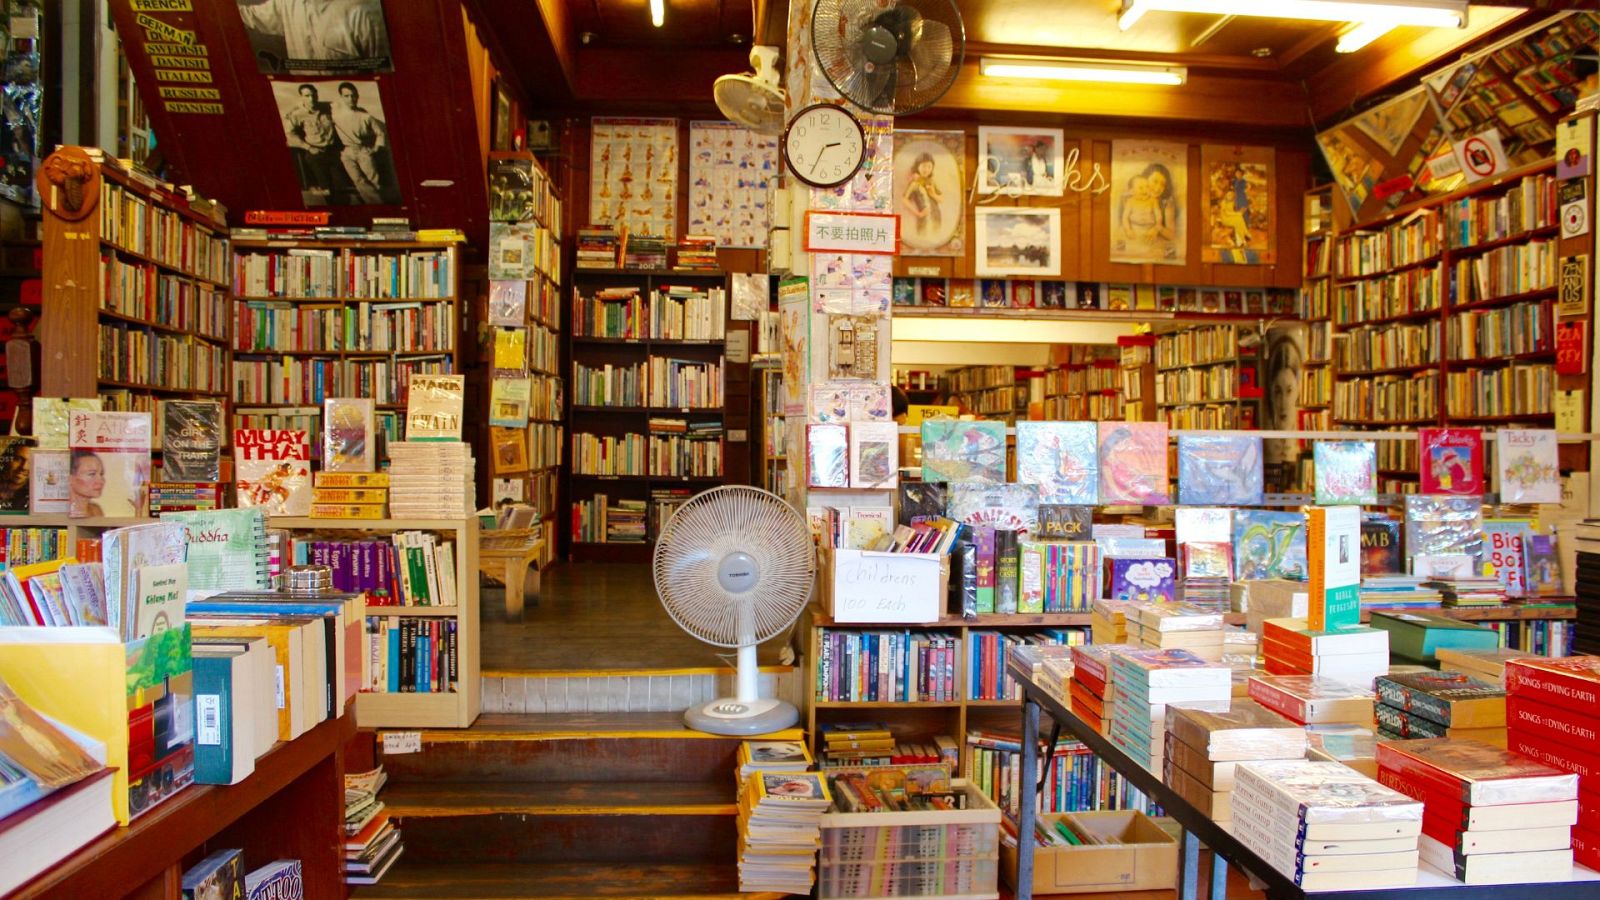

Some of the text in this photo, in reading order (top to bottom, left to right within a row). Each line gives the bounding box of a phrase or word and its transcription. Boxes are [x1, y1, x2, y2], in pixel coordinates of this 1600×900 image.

[135, 0, 187, 9] FRENCH
[139, 15, 192, 46] GERMAN
[147, 44, 205, 55] SWEDISH
[156, 57, 205, 67] DANISH
[158, 71, 210, 81] ITALIAN
[163, 89, 217, 98] RUSSIAN
[168, 103, 221, 113] SPANISH
[809, 116, 816, 127] 11
[820, 113, 830, 125] 12
[796, 126, 807, 137] 10
[845, 127, 853, 138] 2
[792, 140, 800, 151] 9
[849, 142, 857, 153] 3
[796, 154, 804, 165] 8
[844, 157, 851, 166] 4
[819, 169, 828, 179] 6
[833, 165, 842, 176] 5
[816, 225, 888, 243] 不要拍照片
[1564, 263, 1582, 277] ZEN
[1563, 277, 1582, 290] AND
[1565, 289, 1580, 302] US
[412, 379, 461, 391] MARK
[172, 440, 189, 448] ON
[235, 429, 307, 447] MUAY
[1505, 431, 1537, 447] Tacky
[243, 444, 310, 461] THAI
[1046, 521, 1082, 533] PACK
[184, 527, 229, 543] Buddha
[1361, 532, 1390, 548] MB
[1492, 533, 1521, 552] Big
[331, 550, 341, 569] Egypt
[352, 549, 360, 576] Panama
[843, 596, 867, 612] 100
[1378, 685, 1406, 705] PAPILLON
[1518, 676, 1541, 690] SONGS
[1547, 683, 1570, 697] DYING
[1571, 689, 1596, 703] EARTH
[1518, 710, 1541, 725] SONGS
[1548, 719, 1570, 733] DYING
[1571, 725, 1596, 741] EARTH
[1518, 743, 1588, 777] SONGS DYING EARTH
[1237, 766, 1275, 797] Forrest Gump
[1380, 770, 1427, 802] BIRDSONG
[1235, 783, 1254, 800] Forrest
[1255, 795, 1273, 813] Gump
[1232, 795, 1251, 814] Forrest
[1252, 808, 1271, 828] Gump
[1233, 811, 1252, 830] Forrest
[1252, 824, 1271, 844] Gump
[1233, 827, 1271, 860] Forrest Gump
